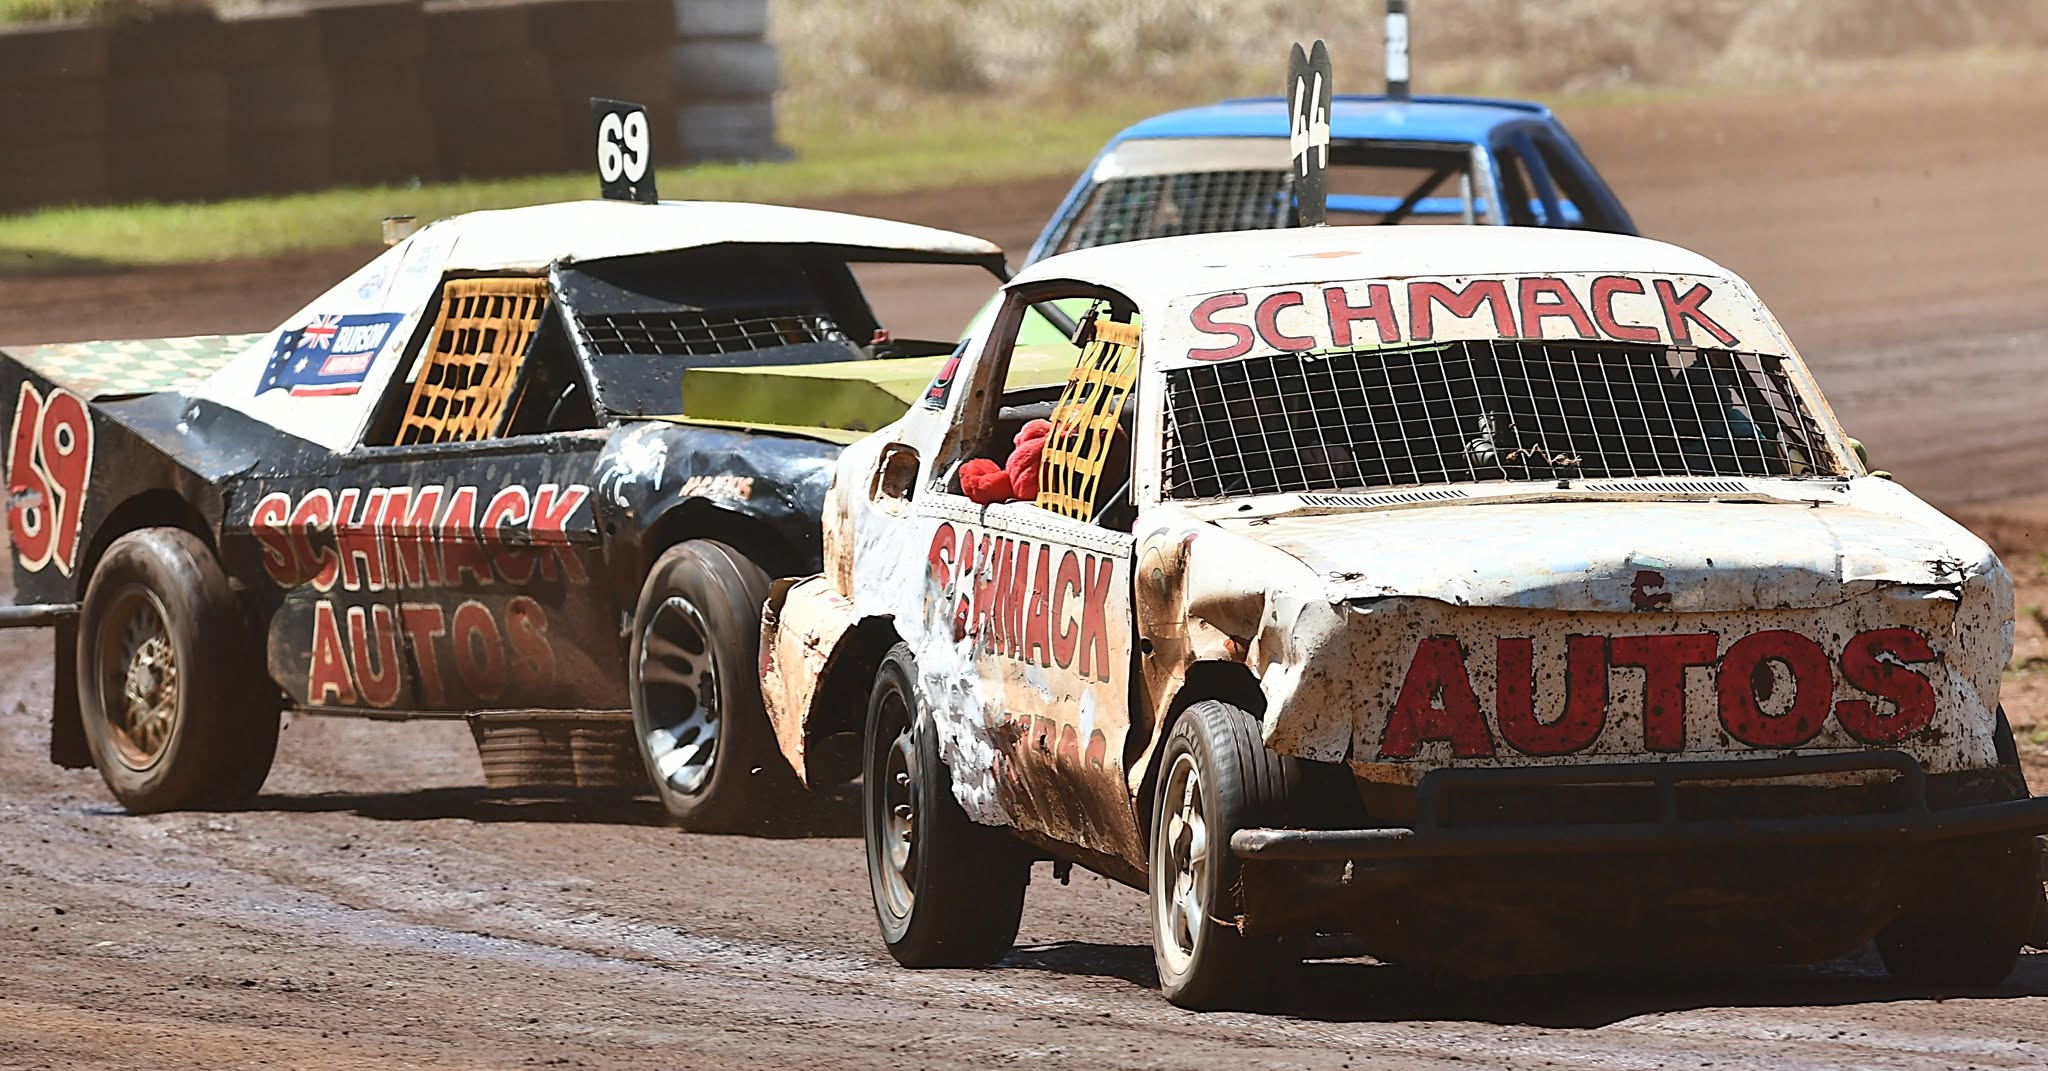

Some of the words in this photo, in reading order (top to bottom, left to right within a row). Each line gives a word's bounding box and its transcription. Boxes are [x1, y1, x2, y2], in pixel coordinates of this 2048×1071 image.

[598, 110, 649, 183] 69
[1291, 72, 1330, 177] 44
[1187, 276, 1738, 362] SCHMACK
[7, 380, 95, 578] 69
[249, 484, 590, 592] SCHMACK
[307, 596, 557, 708] AUTOS
[925, 522, 1114, 684] SCHMACK
[1378, 626, 1939, 760] AUTOS
